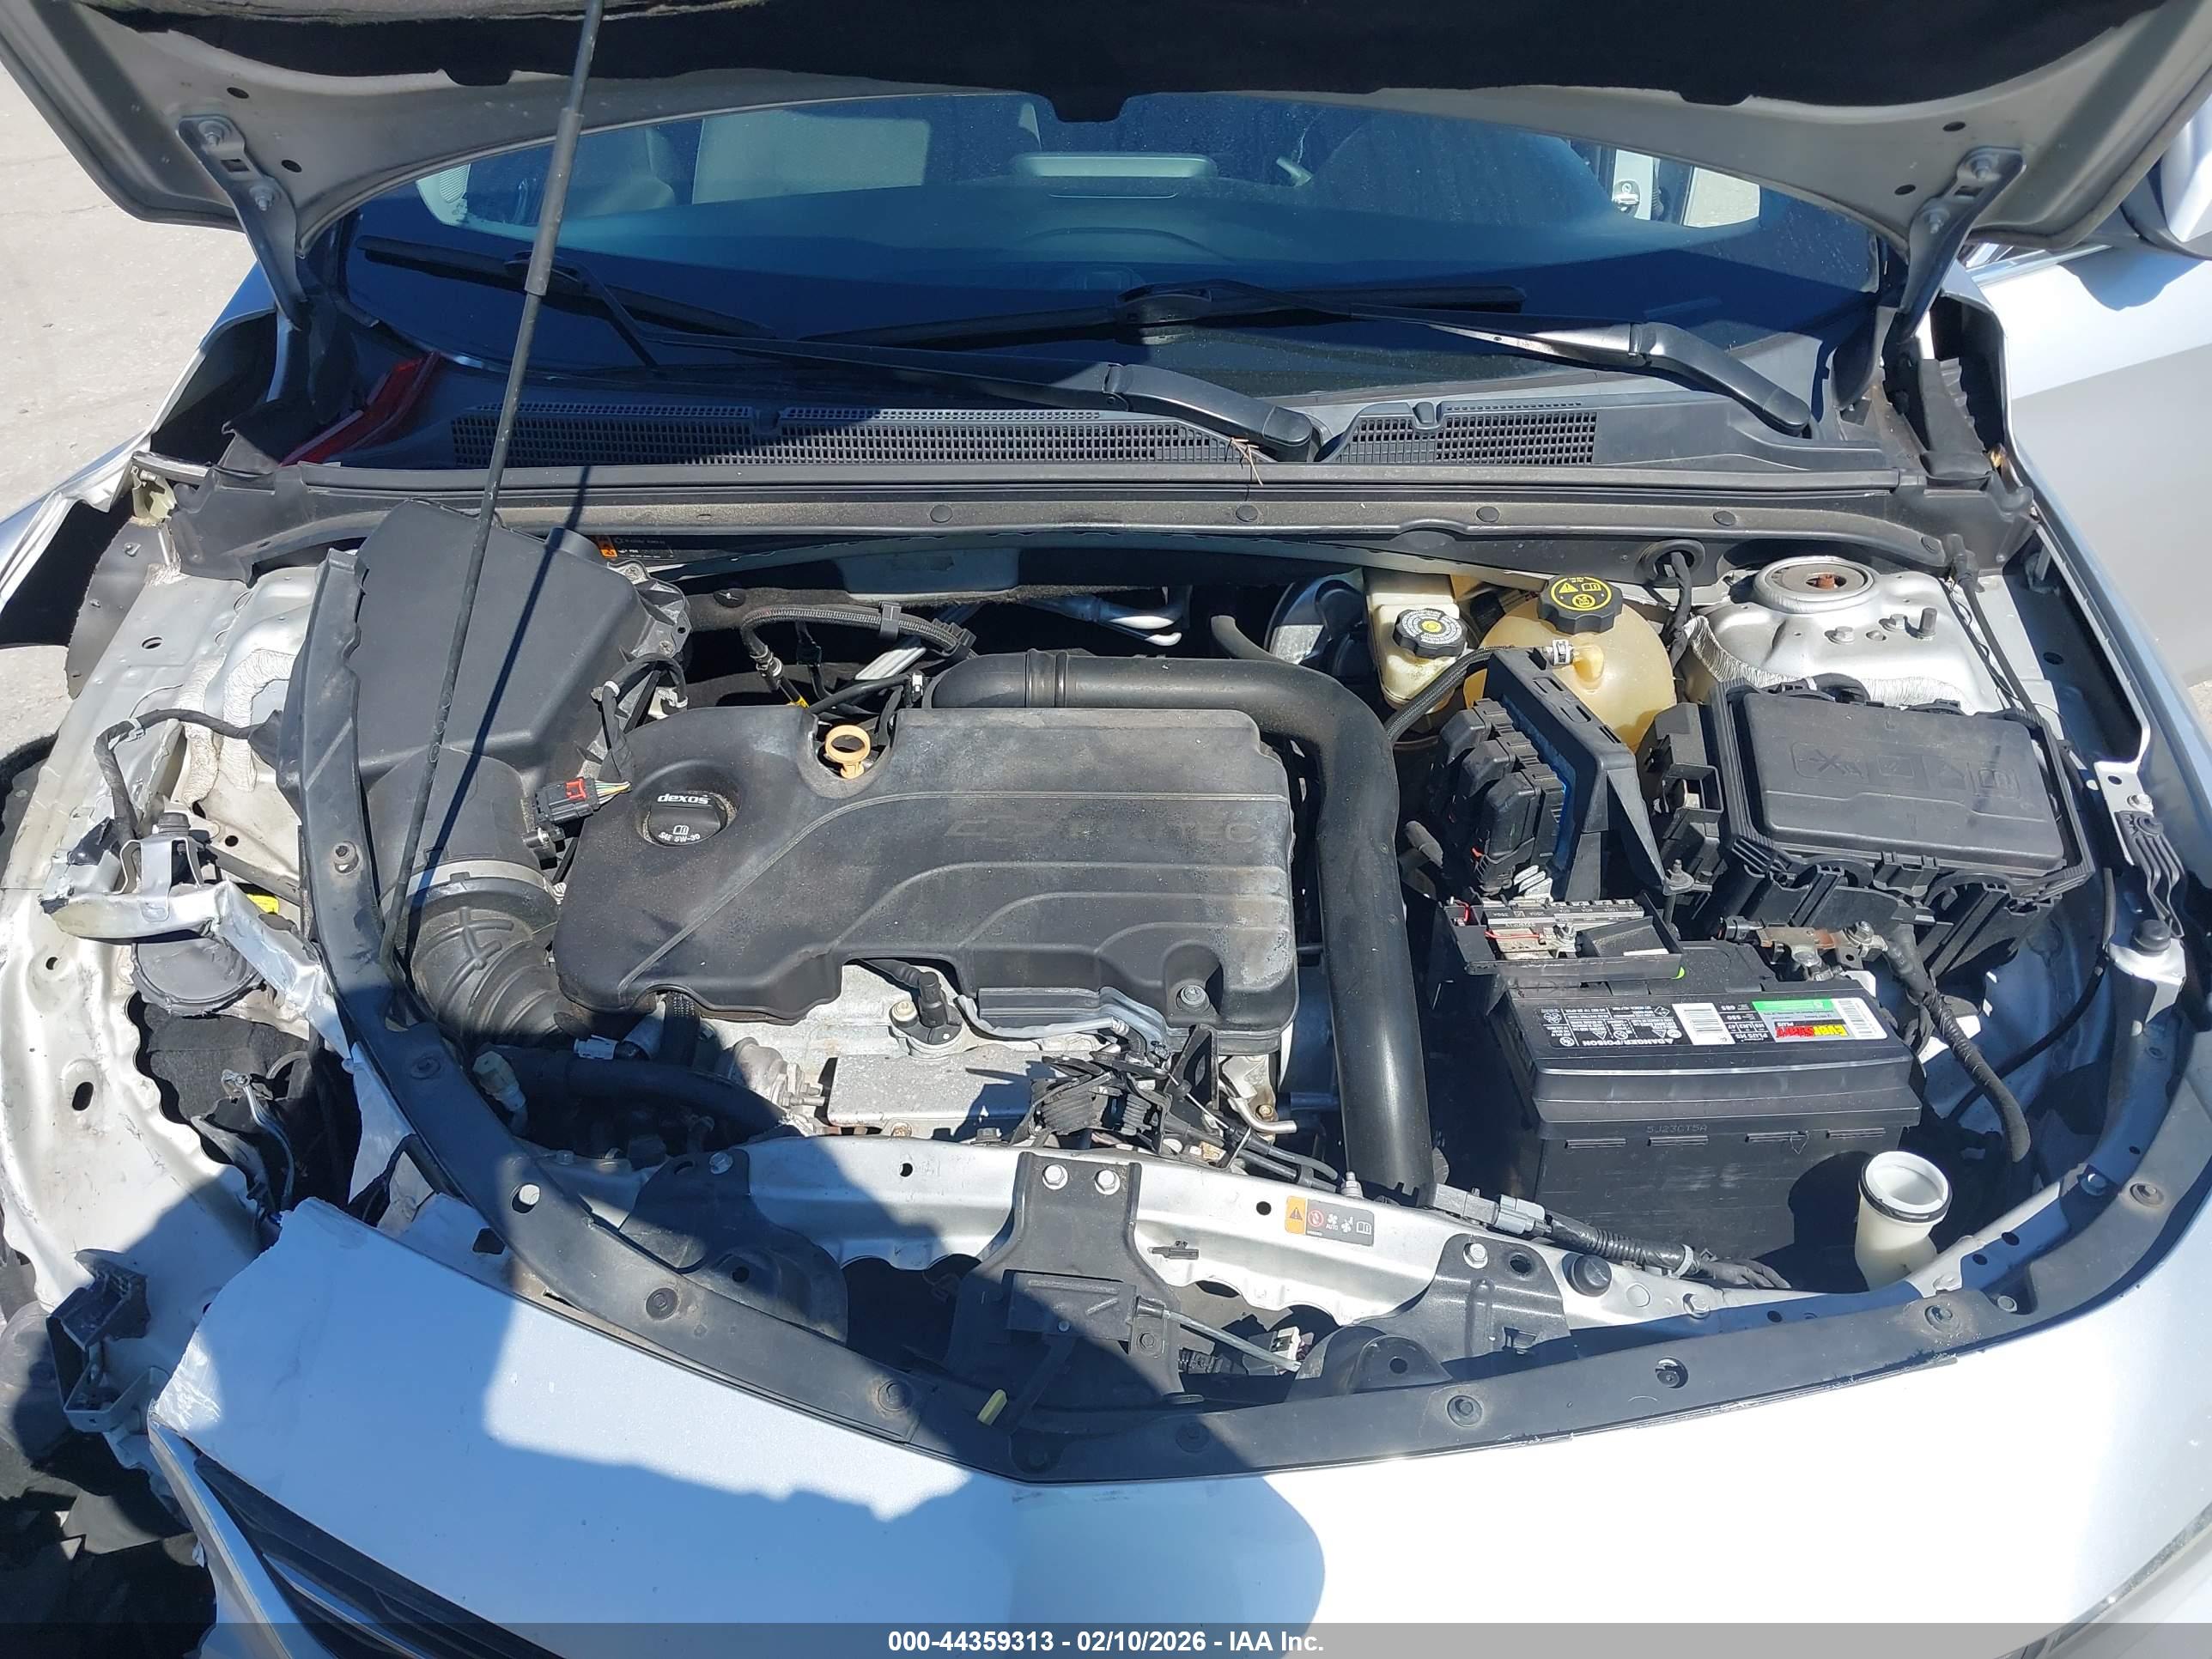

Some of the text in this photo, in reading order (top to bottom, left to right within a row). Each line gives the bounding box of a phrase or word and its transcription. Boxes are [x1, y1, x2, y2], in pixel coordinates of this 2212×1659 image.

[657, 793, 711, 805] dexos
[658, 831, 701, 842] SAE 5W-30
[1776, 1025, 1848, 1038] EverStart
